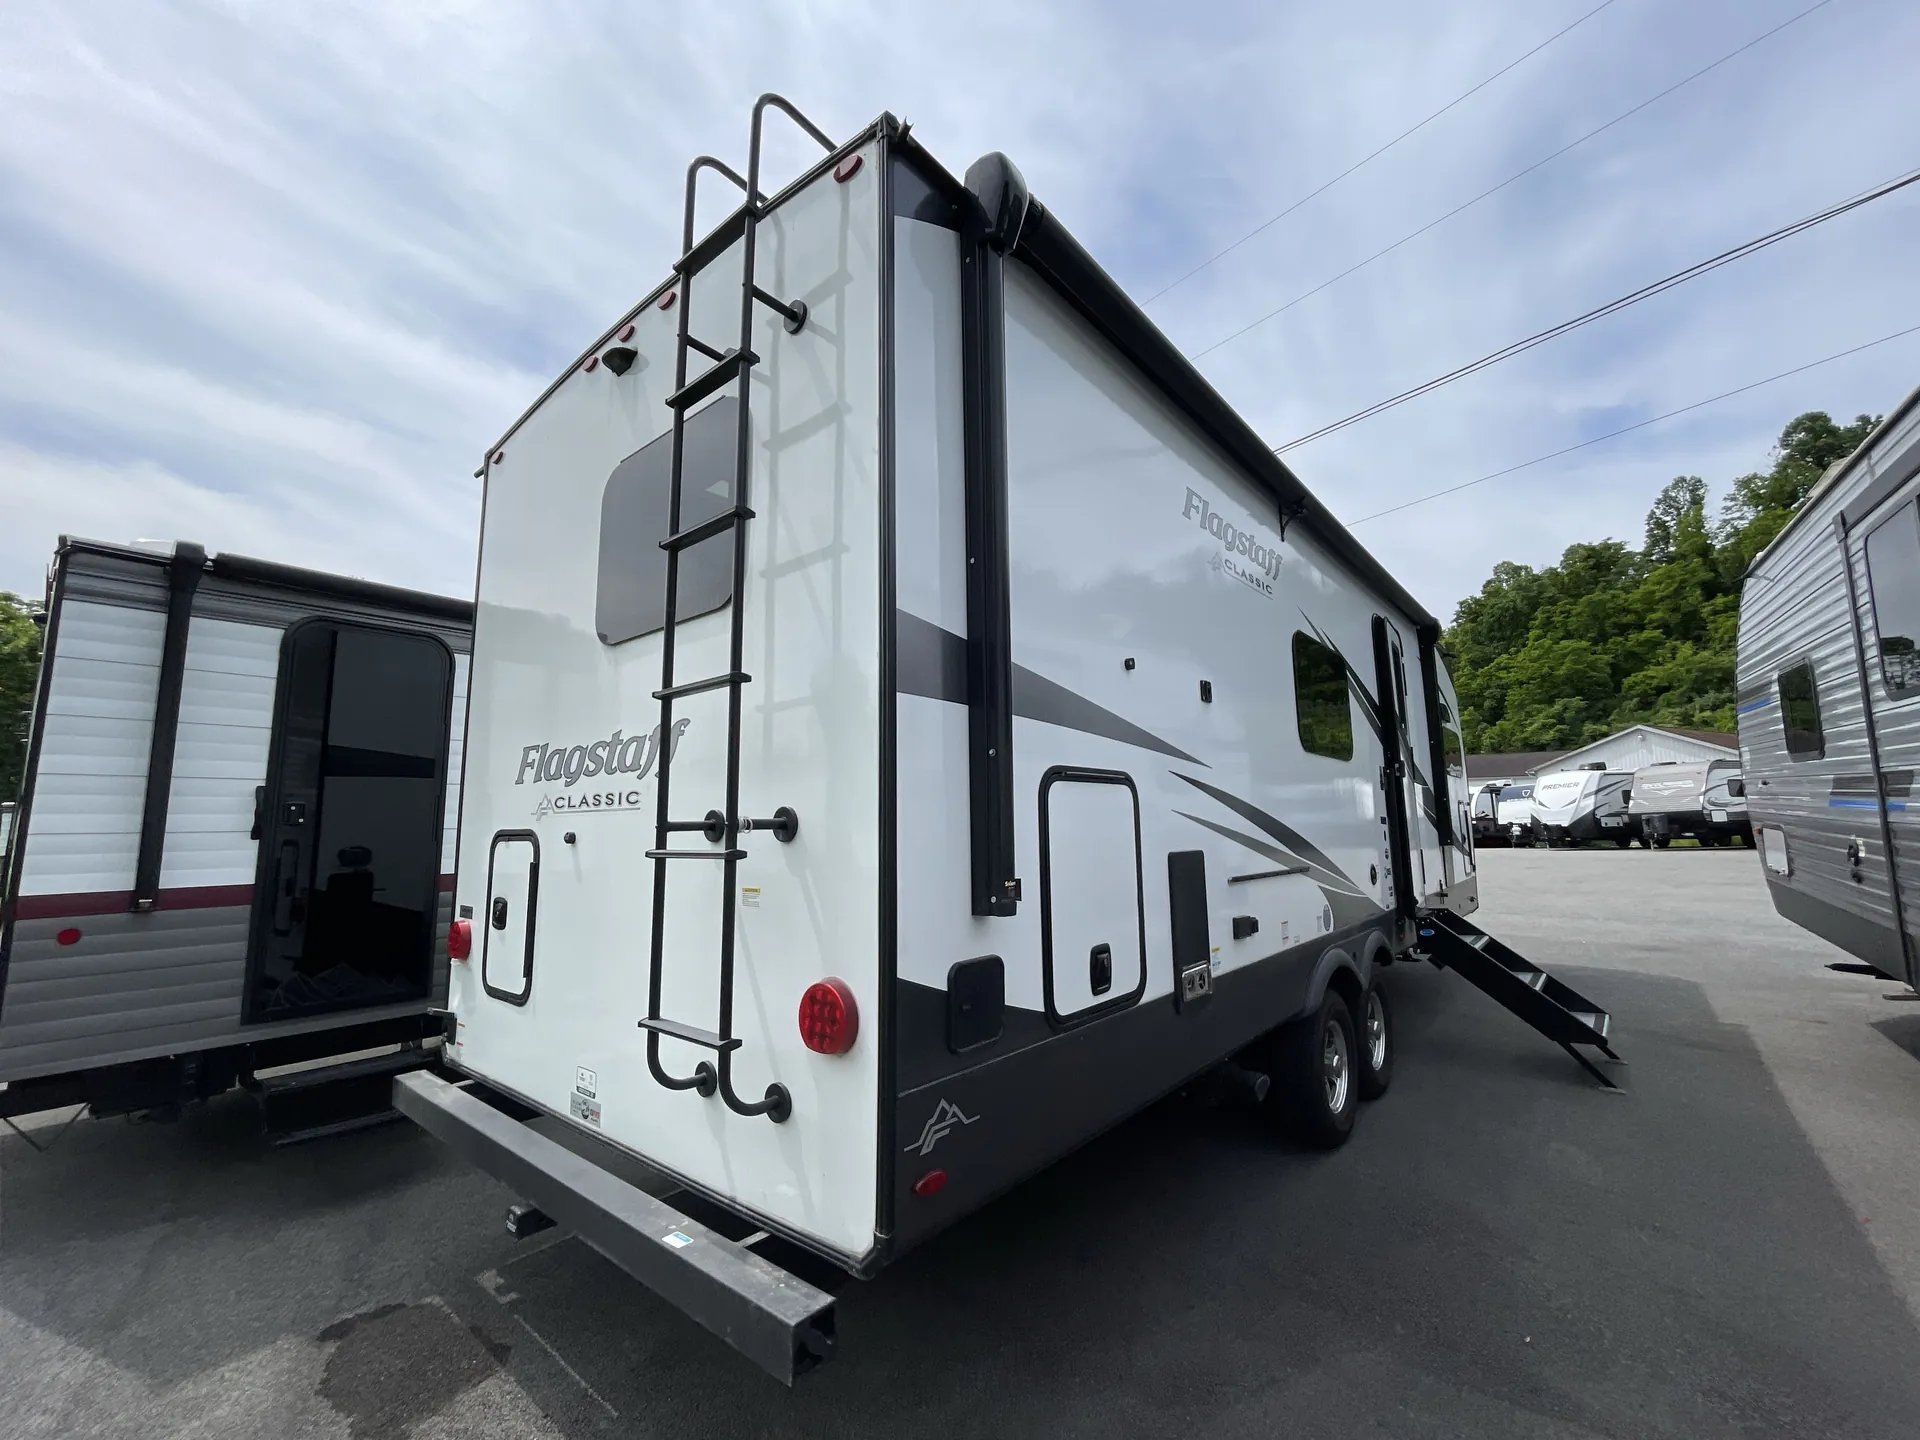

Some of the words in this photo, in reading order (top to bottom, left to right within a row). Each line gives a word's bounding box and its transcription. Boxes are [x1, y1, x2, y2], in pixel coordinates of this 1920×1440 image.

[1182, 487, 1283, 581] Flagstaff
[1224, 559, 1273, 594] CLASSIC
[515, 718, 691, 787] Flagstaff
[555, 791, 640, 808] CLASSIC
[1542, 782, 1579, 790] PREMIER
